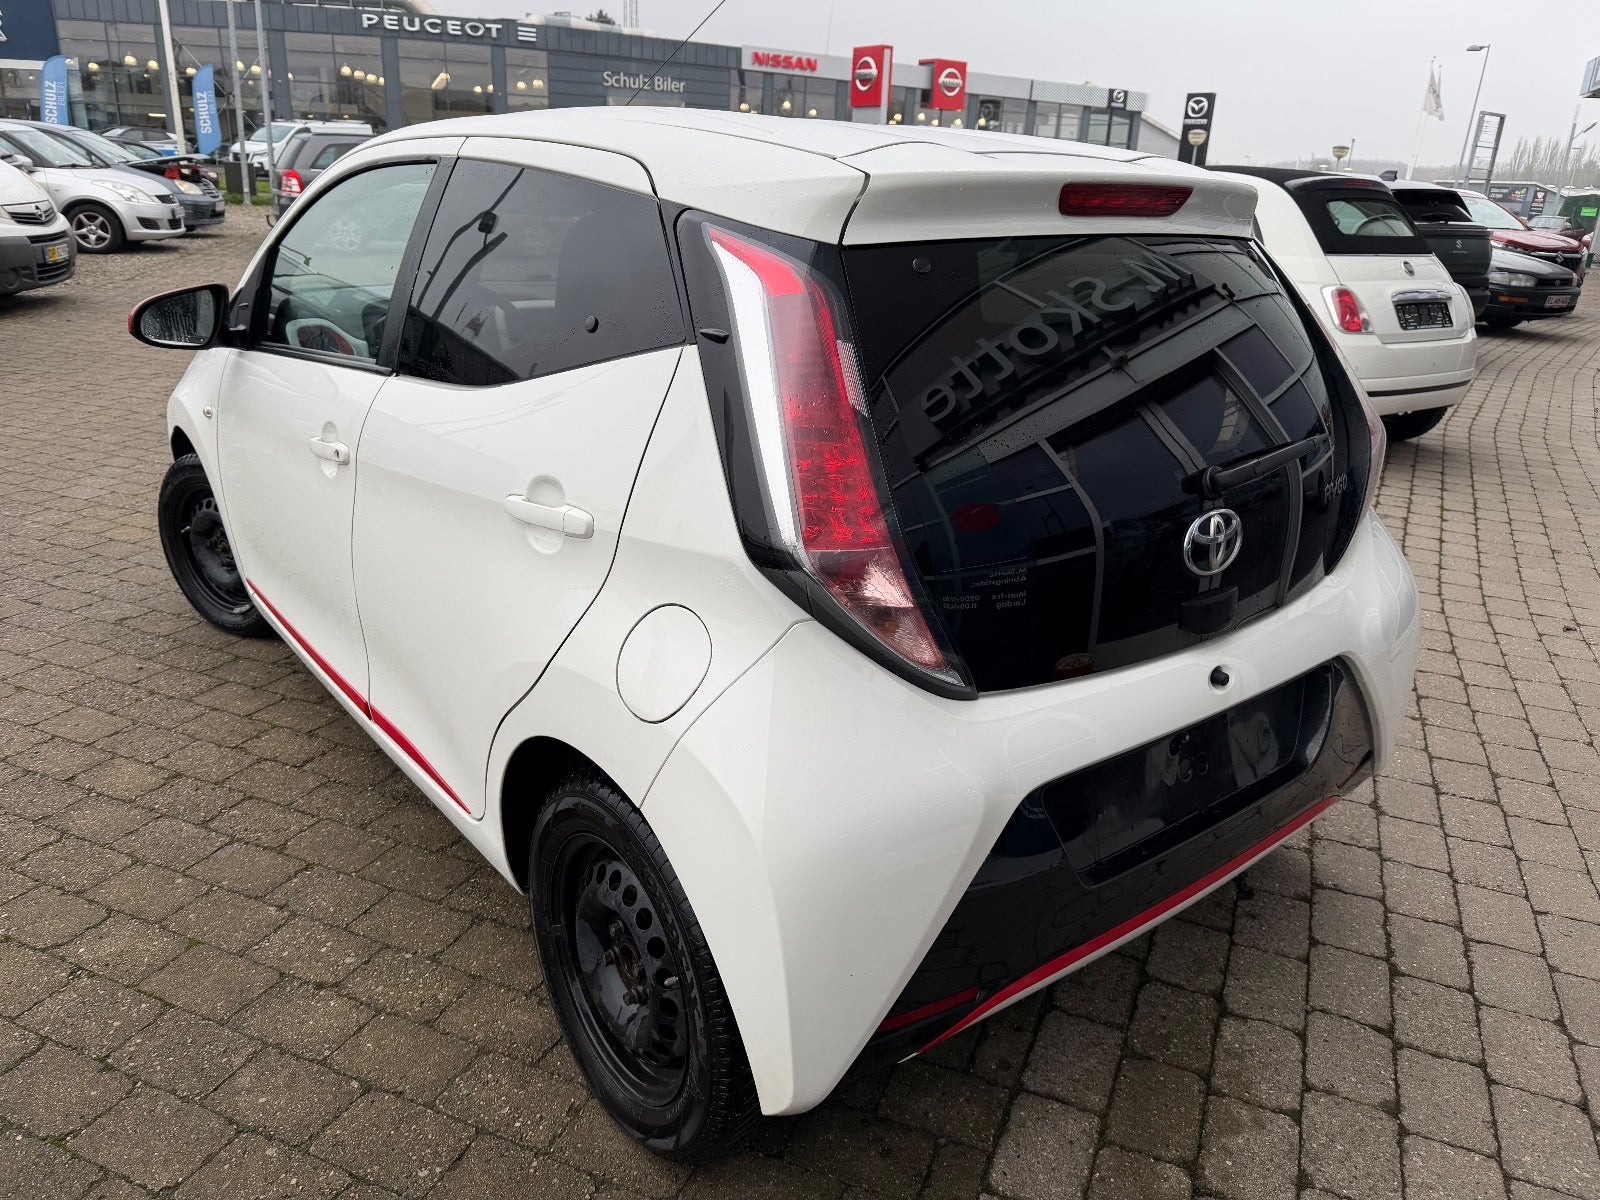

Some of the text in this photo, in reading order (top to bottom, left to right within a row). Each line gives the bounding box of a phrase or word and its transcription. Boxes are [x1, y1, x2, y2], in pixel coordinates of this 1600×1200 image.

[362, 13, 502, 38] PEUGEOT
[752, 51, 818, 71] NISSAN
[603, 70, 686, 93] Schulz Biler
[45, 80, 58, 123] SCHULZ
[196, 91, 212, 134] SCHULZ
